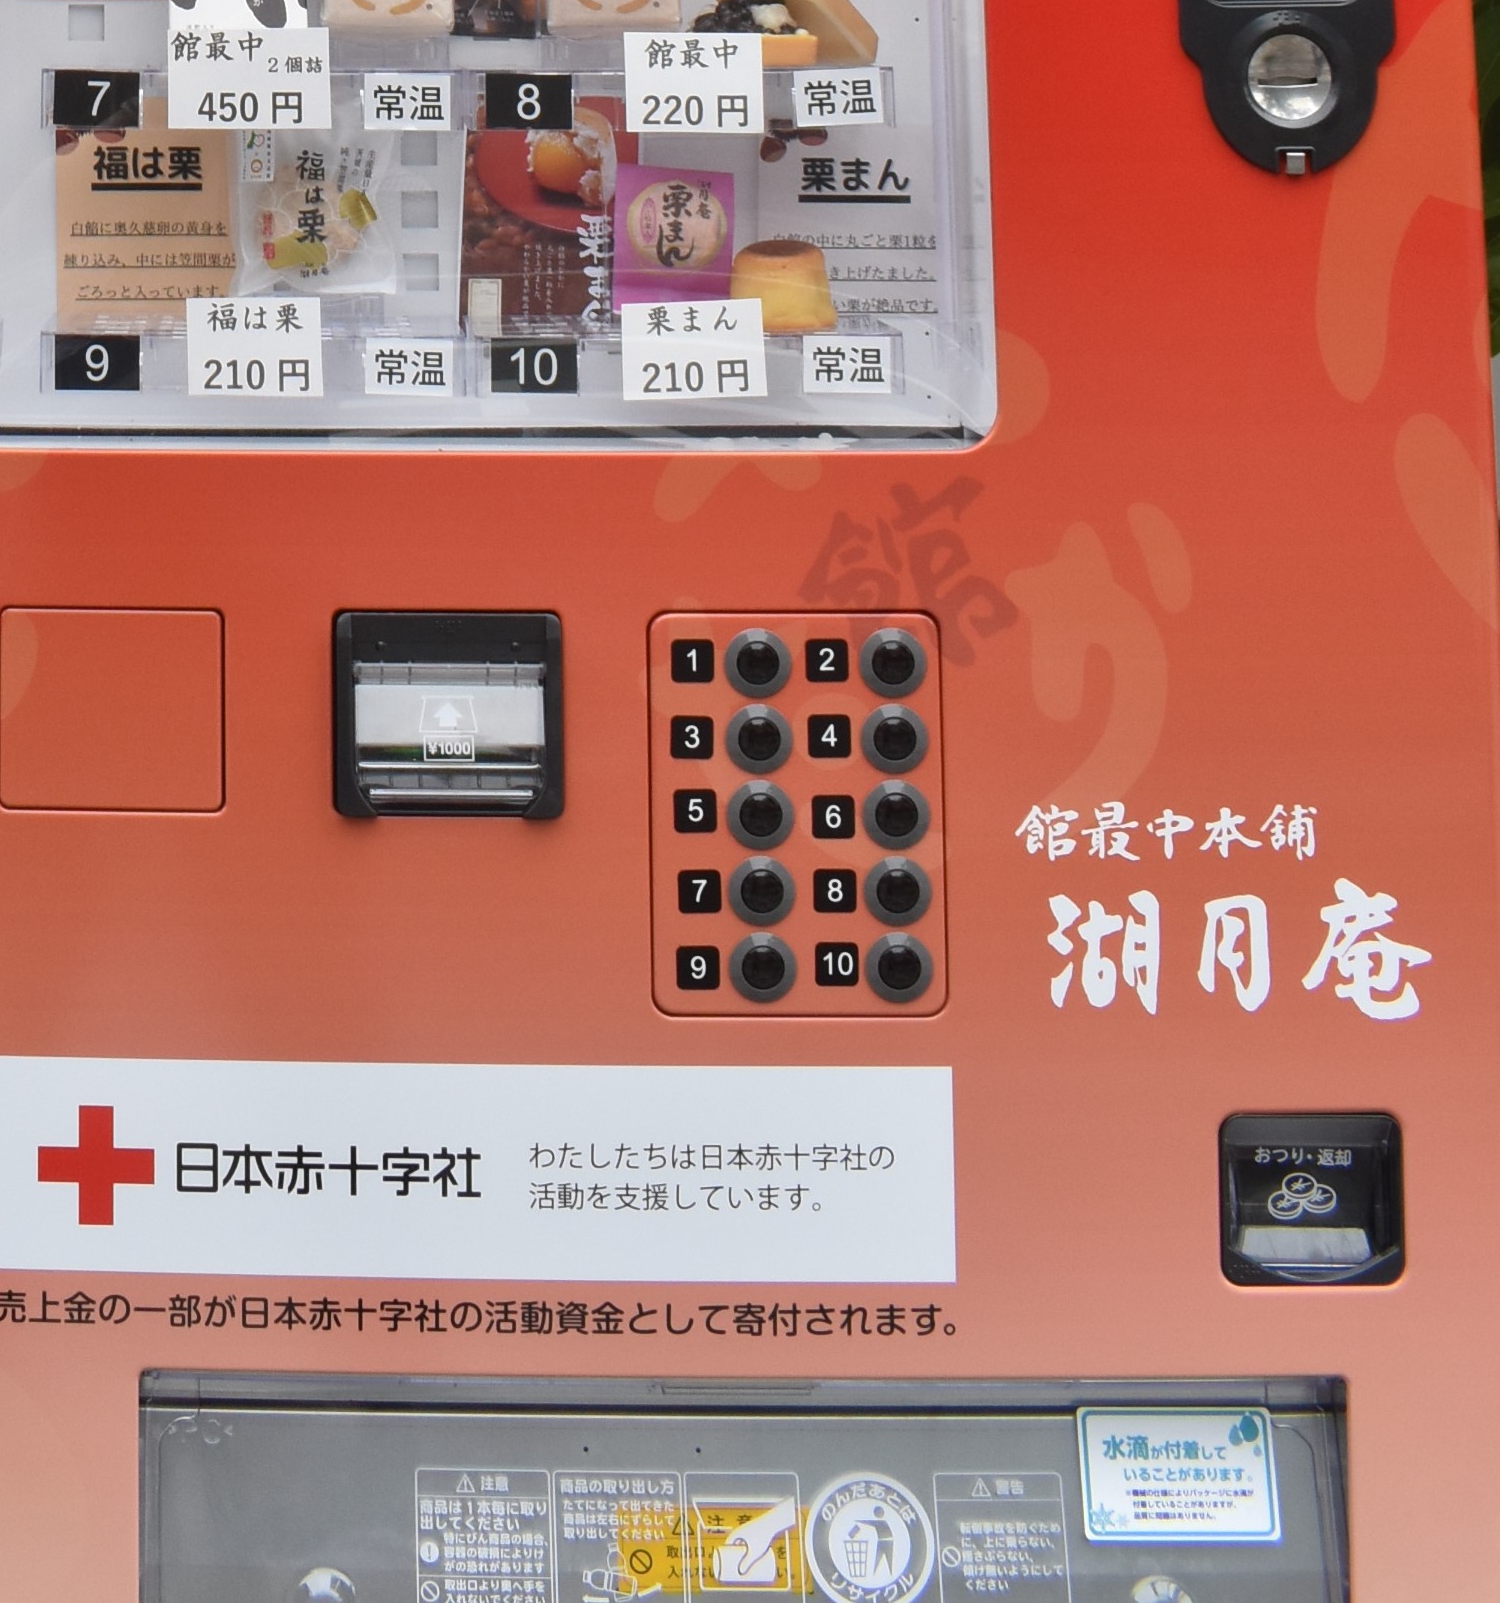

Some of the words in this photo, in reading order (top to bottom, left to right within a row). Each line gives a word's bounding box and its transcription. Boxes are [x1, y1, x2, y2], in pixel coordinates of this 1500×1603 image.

[171, 31, 265, 62] 館最中
[268, 56, 324, 74] 2個詰
[644, 38, 740, 71] 館最中
[87, 80, 111, 117] 7
[372, 85, 445, 122] 常温
[516, 83, 541, 121] 8
[803, 79, 878, 117] 常温
[93, 145, 203, 180] 福は栗
[801, 157, 910, 192] 栗まん
[295, 149, 328, 244] 福は栗
[70, 220, 229, 236] 白餡に奥久慈卵の黄身を
[655, 184, 695, 268] 栗まん
[63, 252, 236, 268] 練り込み、中には笠間栗が
[77, 283, 225, 299] ごろっと入っています。
[206, 303, 304, 334] 福は栗
[646, 305, 739, 336] 栗まん
[85, 344, 110, 382] 9
[374, 349, 447, 387] 常温
[510, 347, 559, 386] 10
[812, 346, 885, 384] 常温
[686, 649, 699, 672] 1
[818, 648, 835, 672] 2
[684, 726, 700, 749] 3
[820, 725, 838, 747] 4
[428, 741, 471, 757] ¥1000
[687, 800, 704, 823] 5
[825, 806, 842, 829] 6
[1014, 800, 1319, 861] 館最中本舗
[692, 879, 708, 903] 7
[827, 880, 843, 903] 8
[1047, 877, 1433, 1020] 湖月庵
[690, 957, 706, 980] 9
[823, 953, 854, 976] 10
[528, 1141, 897, 1172] わたしたちは日本赤十字社の
[1254, 1146, 1352, 1168] おつり・返却
[175, 1141, 483, 1199] 日本赤十字社
[528, 1181, 824, 1213] 活動を支援しています。
[1102, 1435, 1227, 1461] 水滴が付着して
[480, 1475, 509, 1493] 注意
[1123, 1466, 1253, 1483] いることがあります。
[559, 1478, 675, 1495] 商品の取り出し方
[995, 1479, 1025, 1495] 警告
[419, 1500, 548, 1516] 商品は1本毎に取り
[562, 1500, 675, 1512] たてになって出てきた
[820, 1482, 919, 1526] のんだあとは
[419, 1516, 520, 1531] 出してください
[562, 1514, 675, 1526] 商品は左右にずらして
[443, 1532, 549, 1546] 特にびん商品の場合、
[563, 1528, 666, 1540] 取り出してください
[443, 1547, 545, 1560] 容器の破損によりけ
[444, 1561, 545, 1574] がの恐れがあります
[444, 1579, 546, 1592] 取出口より奥へ手を
[965, 1579, 1010, 1591] ください
